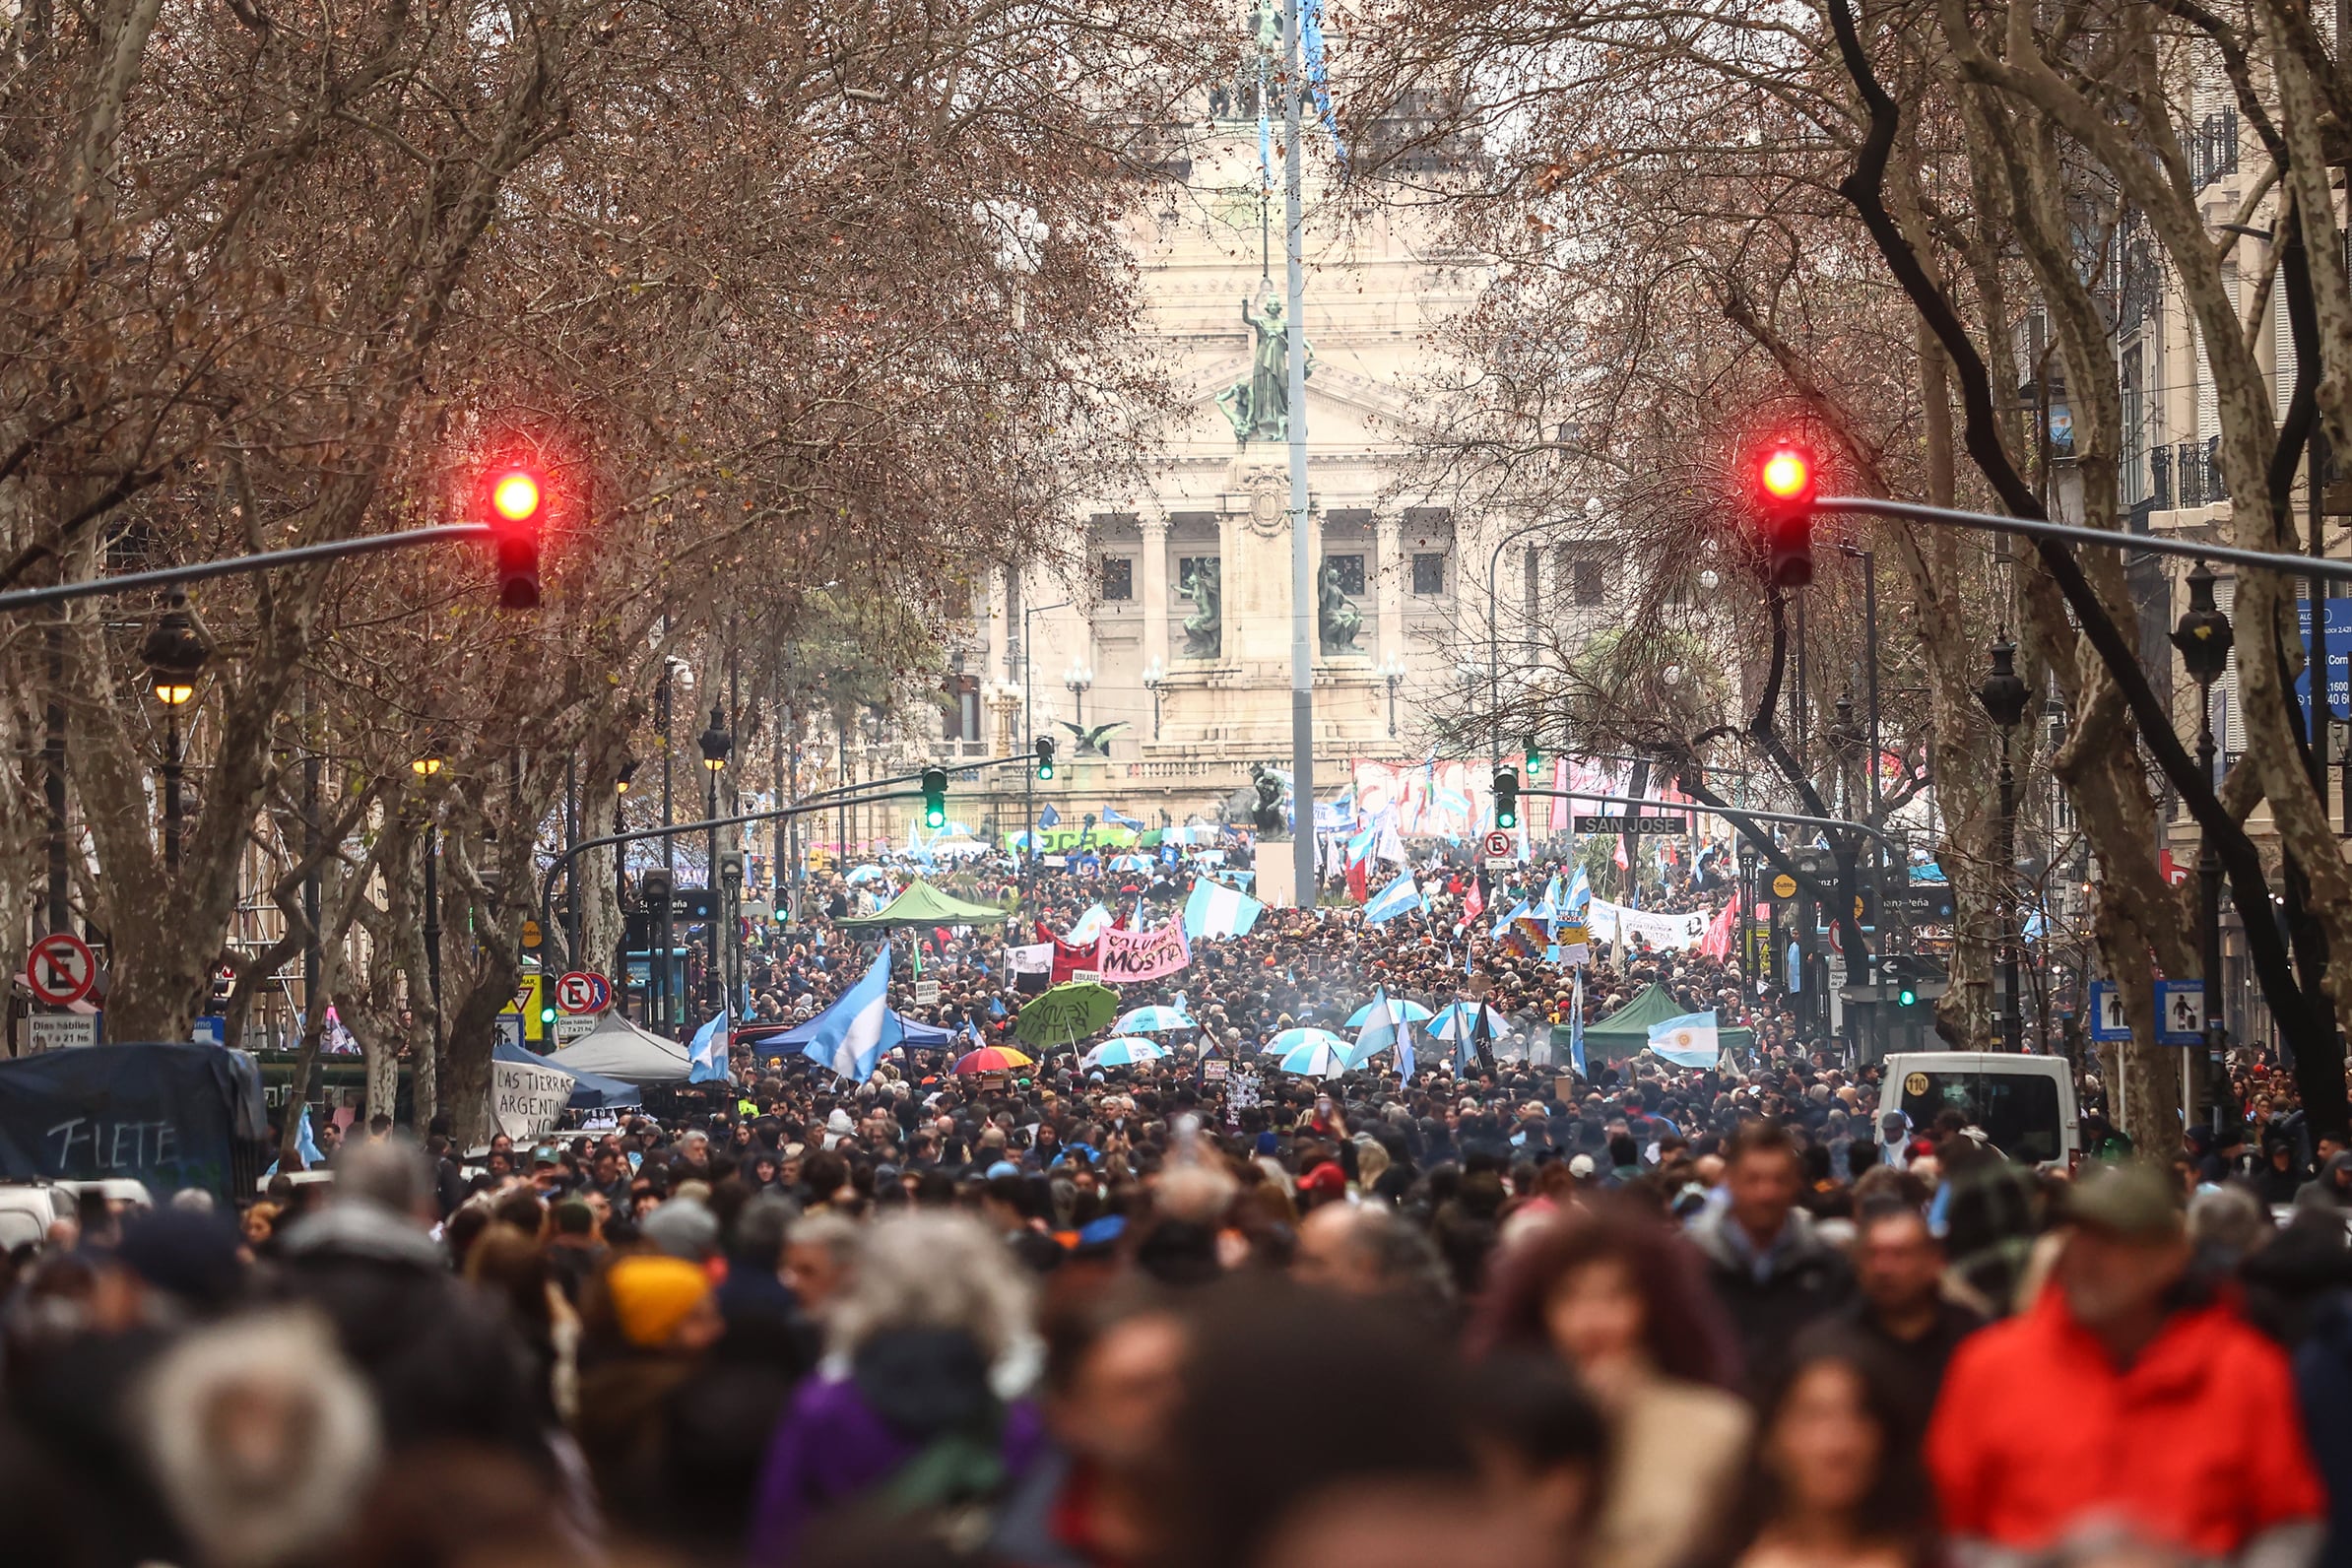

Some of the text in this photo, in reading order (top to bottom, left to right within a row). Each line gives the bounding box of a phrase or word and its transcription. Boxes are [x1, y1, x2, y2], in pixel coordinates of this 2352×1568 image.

[1585, 818, 1675, 833] SAN JOSE
[672, 899, 687, 908] eña
[1909, 897, 1929, 907] eña
[64, 1033, 74, 1043] 21
[497, 1071, 572, 1094] LAS TIERRAS
[1908, 1078, 1927, 1092] 110
[46, 1117, 180, 1170] FLETE
